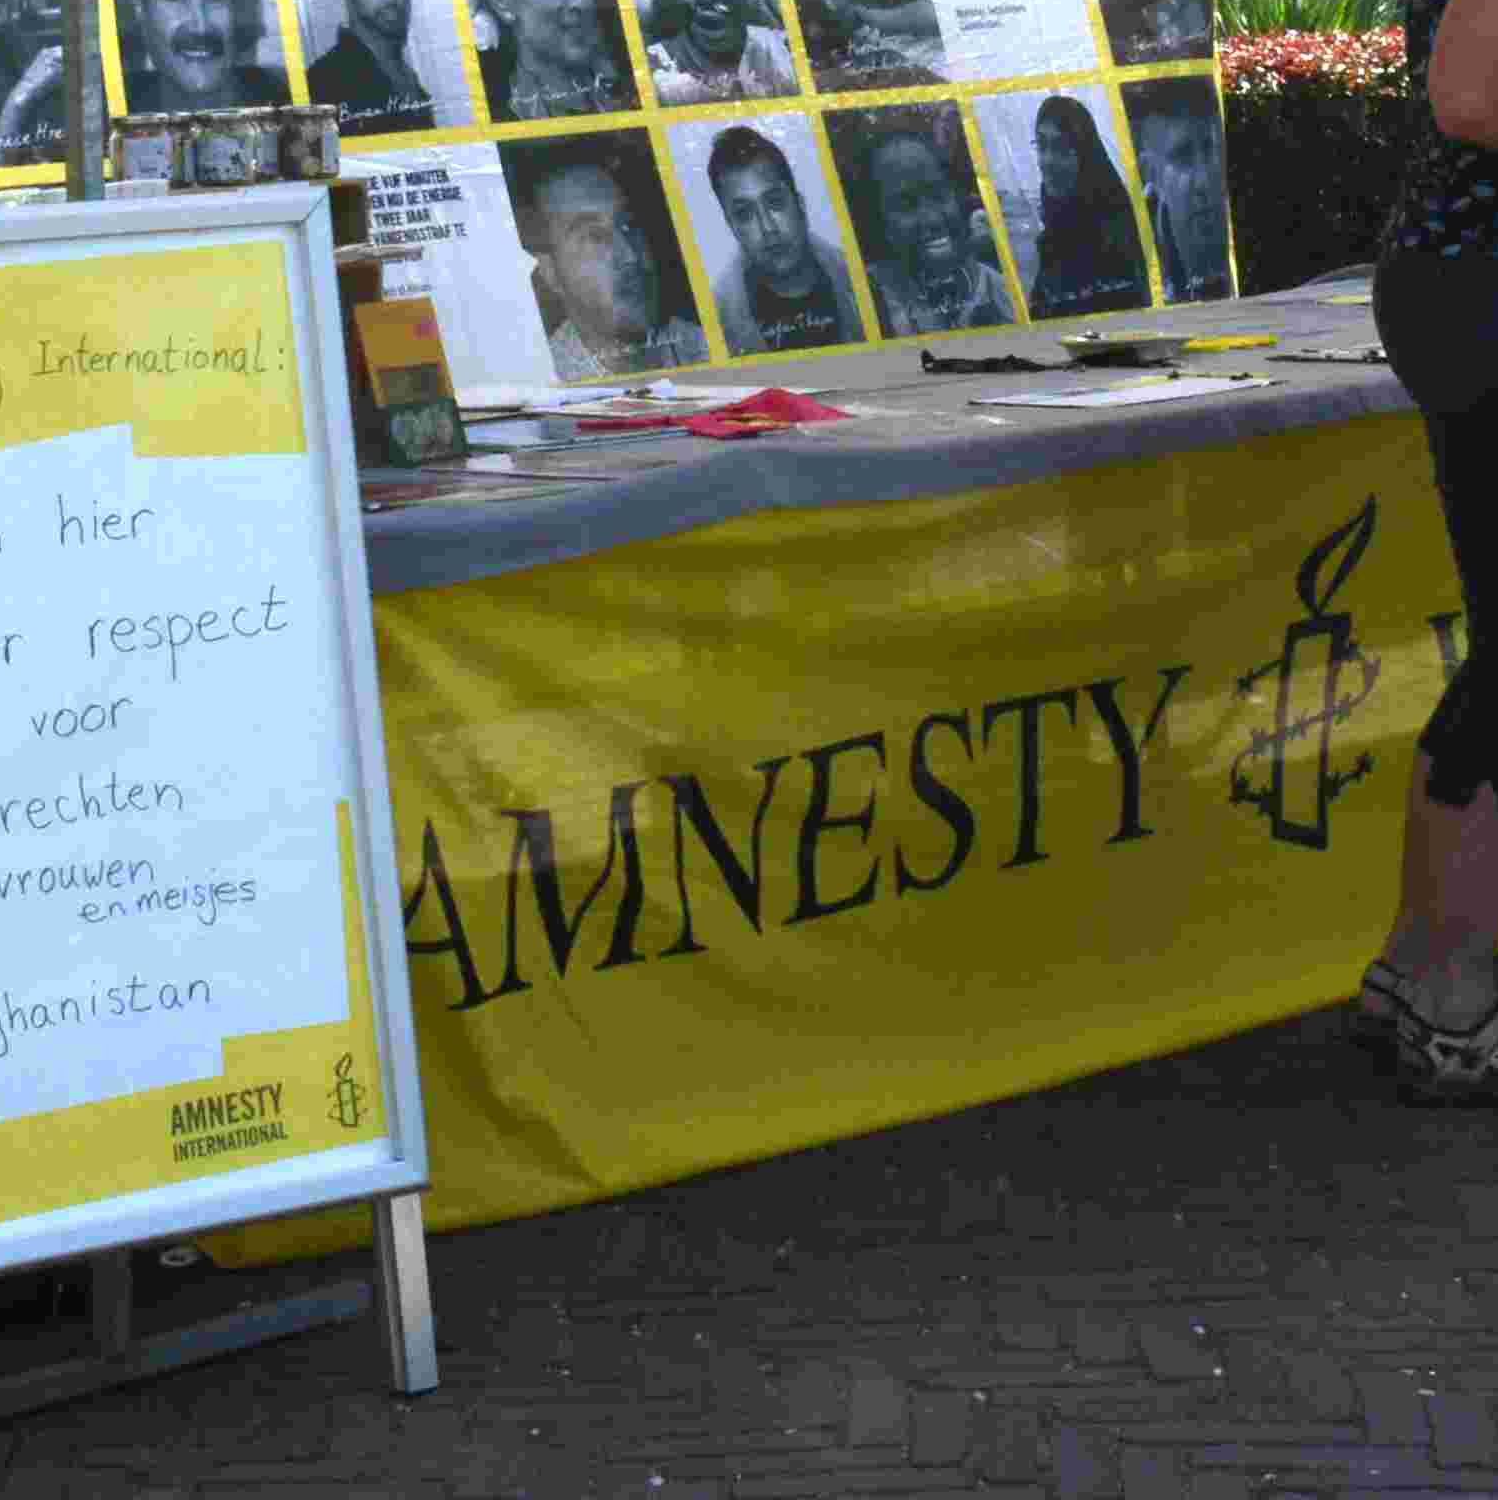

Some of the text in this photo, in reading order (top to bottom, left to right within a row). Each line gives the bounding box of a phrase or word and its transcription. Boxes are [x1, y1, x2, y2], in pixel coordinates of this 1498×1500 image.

[453, 221, 469, 237] TE
[56, 492, 158, 548] hier
[87, 583, 290, 681] respect
[30, 694, 132, 740] voor
[0, 772, 185, 838] rechten
[402, 663, 1196, 1012] AMNESTY
[77, 867, 258, 927] en meisjes
[169, 1081, 285, 1137] AMNESTY
[172, 1121, 289, 1163] INTERNATIONAL
